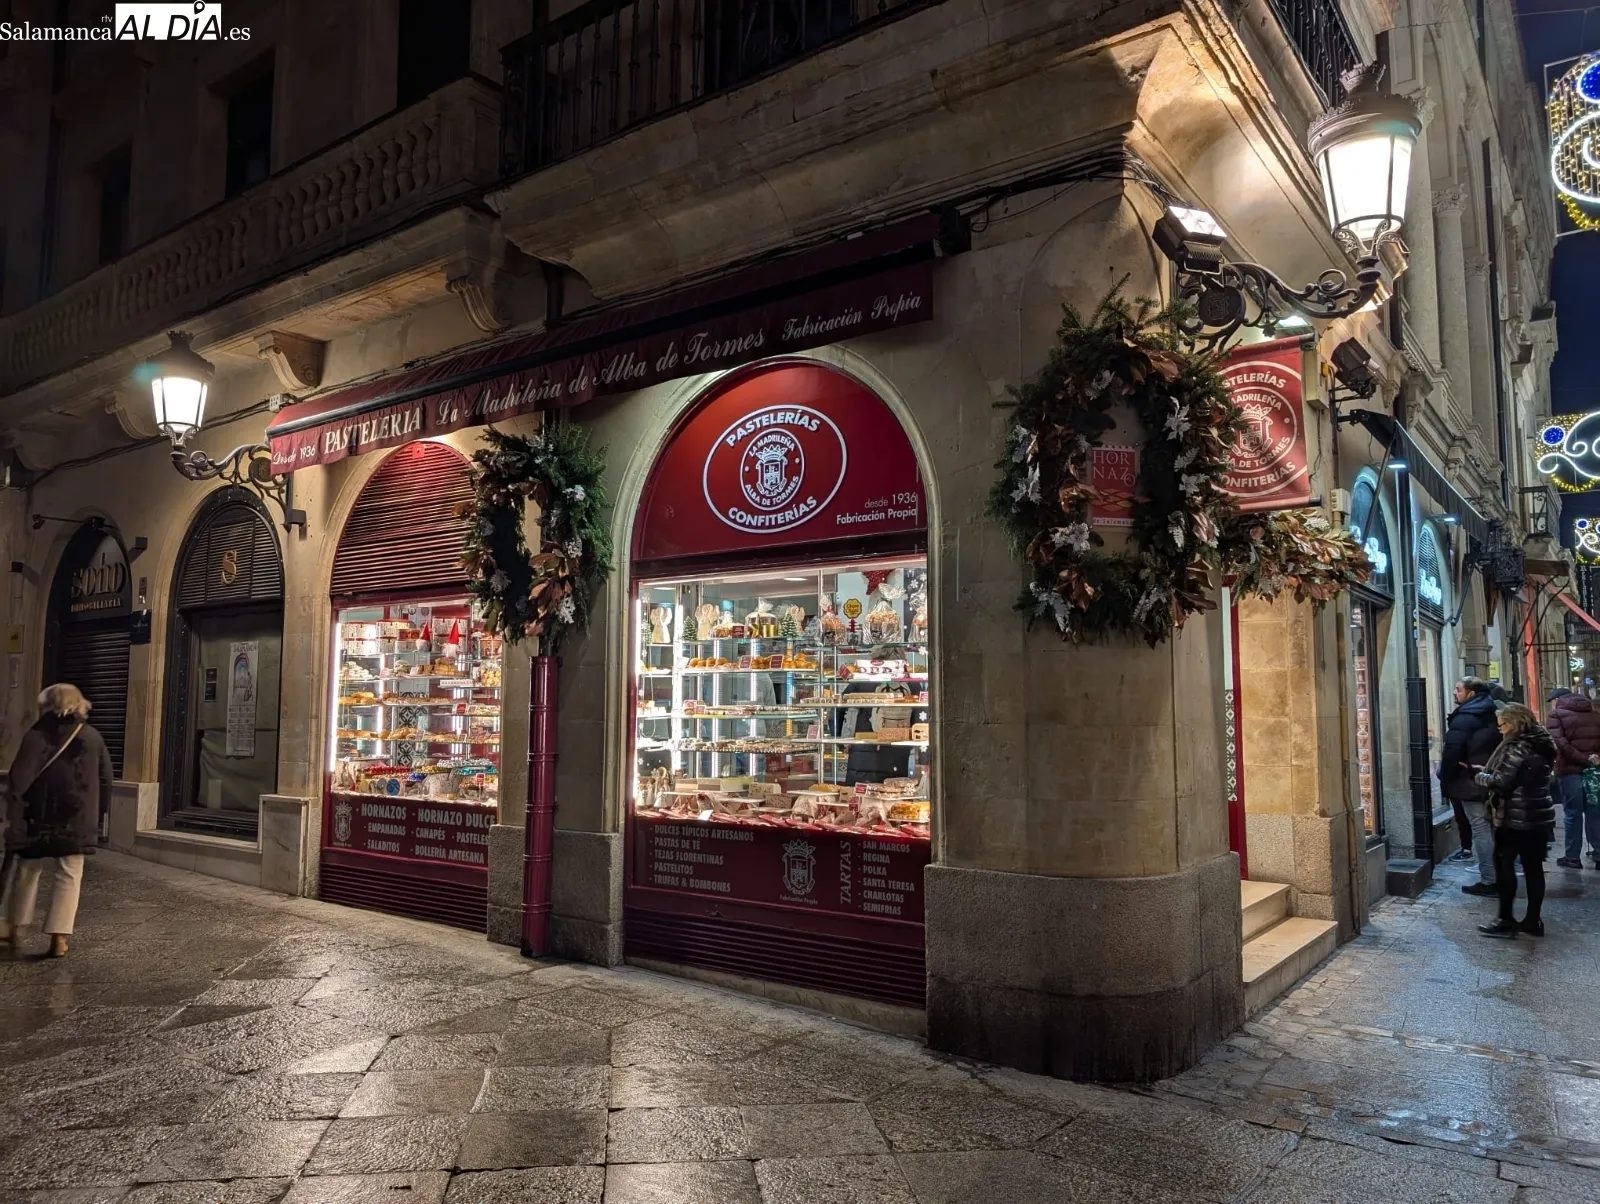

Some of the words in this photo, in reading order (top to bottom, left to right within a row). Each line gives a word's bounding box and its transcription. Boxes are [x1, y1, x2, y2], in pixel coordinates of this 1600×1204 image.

[272, 450, 297, 465] Desde
[300, 445, 316, 460] 1936
[436, 398, 458, 426] La
[465, 378, 563, 418] Madrileña
[568, 364, 589, 394] de
[593, 352, 647, 386] Alba
[656, 341, 680, 372] de
[683, 328, 766, 365] Tormes
[782, 305, 863, 341] Fabricación
[870, 291, 922, 322] Propia
[1222, 371, 1287, 389] STELERÍAS
[726, 409, 821, 447] PASTELERÍAS
[749, 445, 758, 457] LA
[757, 434, 795, 452] MADRILEÑA
[1239, 460, 1252, 468] DE
[1254, 436, 1291, 466] TORMES
[1093, 450, 1130, 465] HOR
[1222, 461, 1296, 488] ONFITERÍAS
[745, 484, 760, 503] ALBA
[762, 498, 771, 506] DE
[772, 475, 799, 504] TORMES
[864, 496, 889, 509] desde
[892, 492, 917, 505] 1936
[728, 496, 818, 527] CONFITERÍAS
[836, 510, 885, 525] Fabricación
[888, 505, 917, 520] Propia
[361, 803, 407, 820] HORNAZOS
[418, 808, 462, 826] HORNAZO
[465, 812, 496, 828] DULCE
[368, 822, 406, 836] EMPANADAS
[415, 827, 446, 840] CANAPÉS
[654, 824, 680, 836] DULCES
[682, 825, 709, 838] TÍPICOS
[711, 828, 754, 841] ARTESANOS
[367, 839, 400, 853] SALADITOS
[654, 837, 679, 848] PASTAS
[681, 839, 690, 849] DE
[862, 840, 877, 850] SAN
[879, 842, 910, 853] MARCOS
[415, 844, 446, 859] BOLLERÍA
[448, 849, 485, 864] ARTESANA
[654, 849, 674, 860] TEJAS
[675, 851, 724, 865] FLORENTINAS
[863, 852, 890, 864] REGINA
[654, 862, 694, 875] PASTELITOS
[840, 840, 852, 904] TARTAS
[863, 864, 887, 876] POLKA
[654, 874, 679, 886] TRUFAS
[681, 878, 688, 887] &
[689, 878, 731, 892] BOMBONES
[862, 877, 886, 889] SANTA
[888, 880, 915, 892] TERESA
[863, 890, 904, 903] CHARLOTAS
